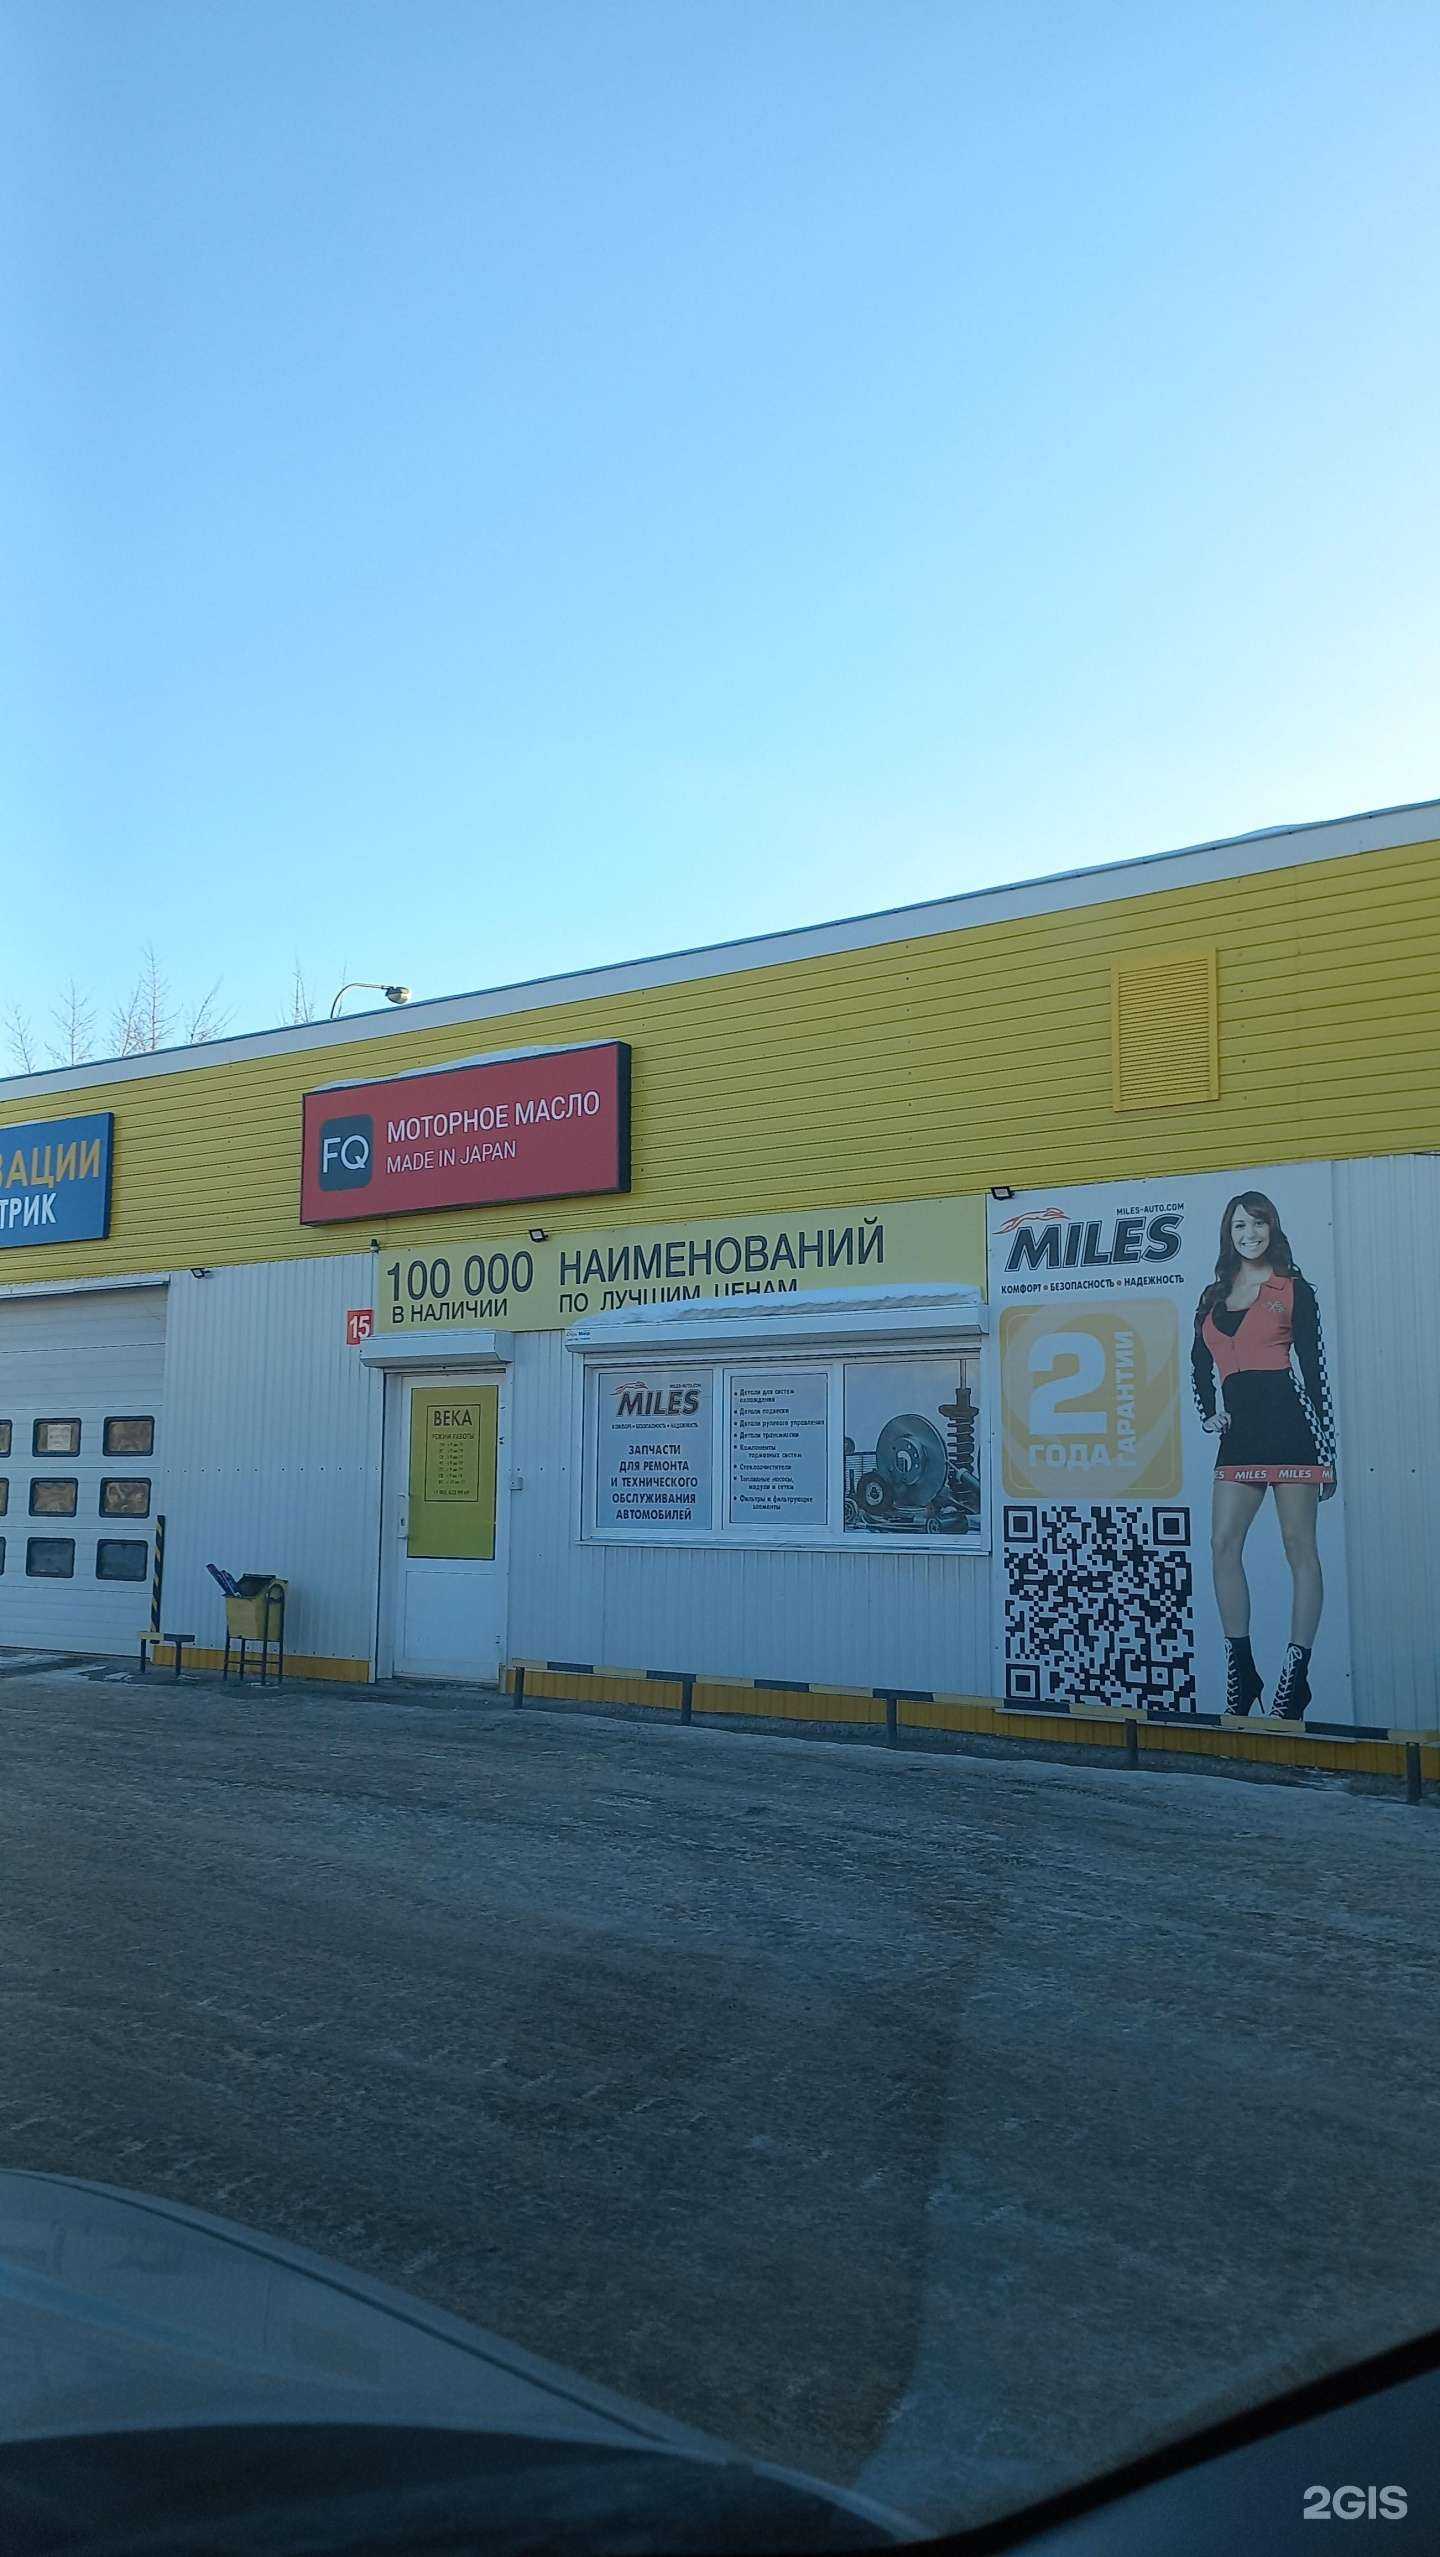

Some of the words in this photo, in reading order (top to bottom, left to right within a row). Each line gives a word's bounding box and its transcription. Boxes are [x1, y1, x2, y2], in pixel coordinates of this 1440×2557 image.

[387, 1104, 508, 1143] МОТОРНОЕ
[515, 1090, 600, 1125] МАСЛО
[0, 1138, 100, 1189] АЦИИ
[321, 1134, 370, 1173] FQ
[386, 1151, 434, 1173] MADE
[438, 1149, 456, 1167] IN
[459, 1140, 516, 1164] JAPAN
[1116, 1202, 1185, 1216] MILES-AUTO.COM
[1004, 1213, 1185, 1273] MILES
[387, 1258, 450, 1301] 100
[464, 1251, 533, 1297] 000
[560, 1216, 885, 1286] НАИМЕНОВАНИЙ
[1001, 1283, 1041, 1295] КОМФОРТ
[1050, 1278, 1115, 1292] БЕЗОПАСНОСТЬ
[1124, 1274, 1185, 1287] НАДЕЖНОСТЬ
[392, 1305, 404, 1323] В
[410, 1298, 508, 1322] НАЛИЧИИ
[559, 1292, 589, 1313] ПО
[350, 1315, 371, 1340] 15
[1028, 1331, 1107, 1435] 2
[617, 1389, 701, 1417] MILES
[1114, 1331, 1137, 1467] ГАРАНТИИ
[433, 1409, 473, 1426] ВЕКА
[629, 1445, 681, 1455] ЗАПЧАСТИ
[1028, 1443, 1111, 1471] ГОДА
[620, 1461, 640, 1473] ДЛЯ
[644, 1460, 689, 1471] РЕМОНТА
[1234, 1470, 1268, 1480] MILES
[1278, 1469, 1312, 1479] MILES
[611, 1478, 618, 1487] И
[622, 1477, 698, 1488] ТЕХНИЧЕСКОГО
[612, 1493, 696, 1504] ОБСЛУЖИВАНИЯ
[616, 1507, 692, 1520] АВТОМОБИЛЕЙ
